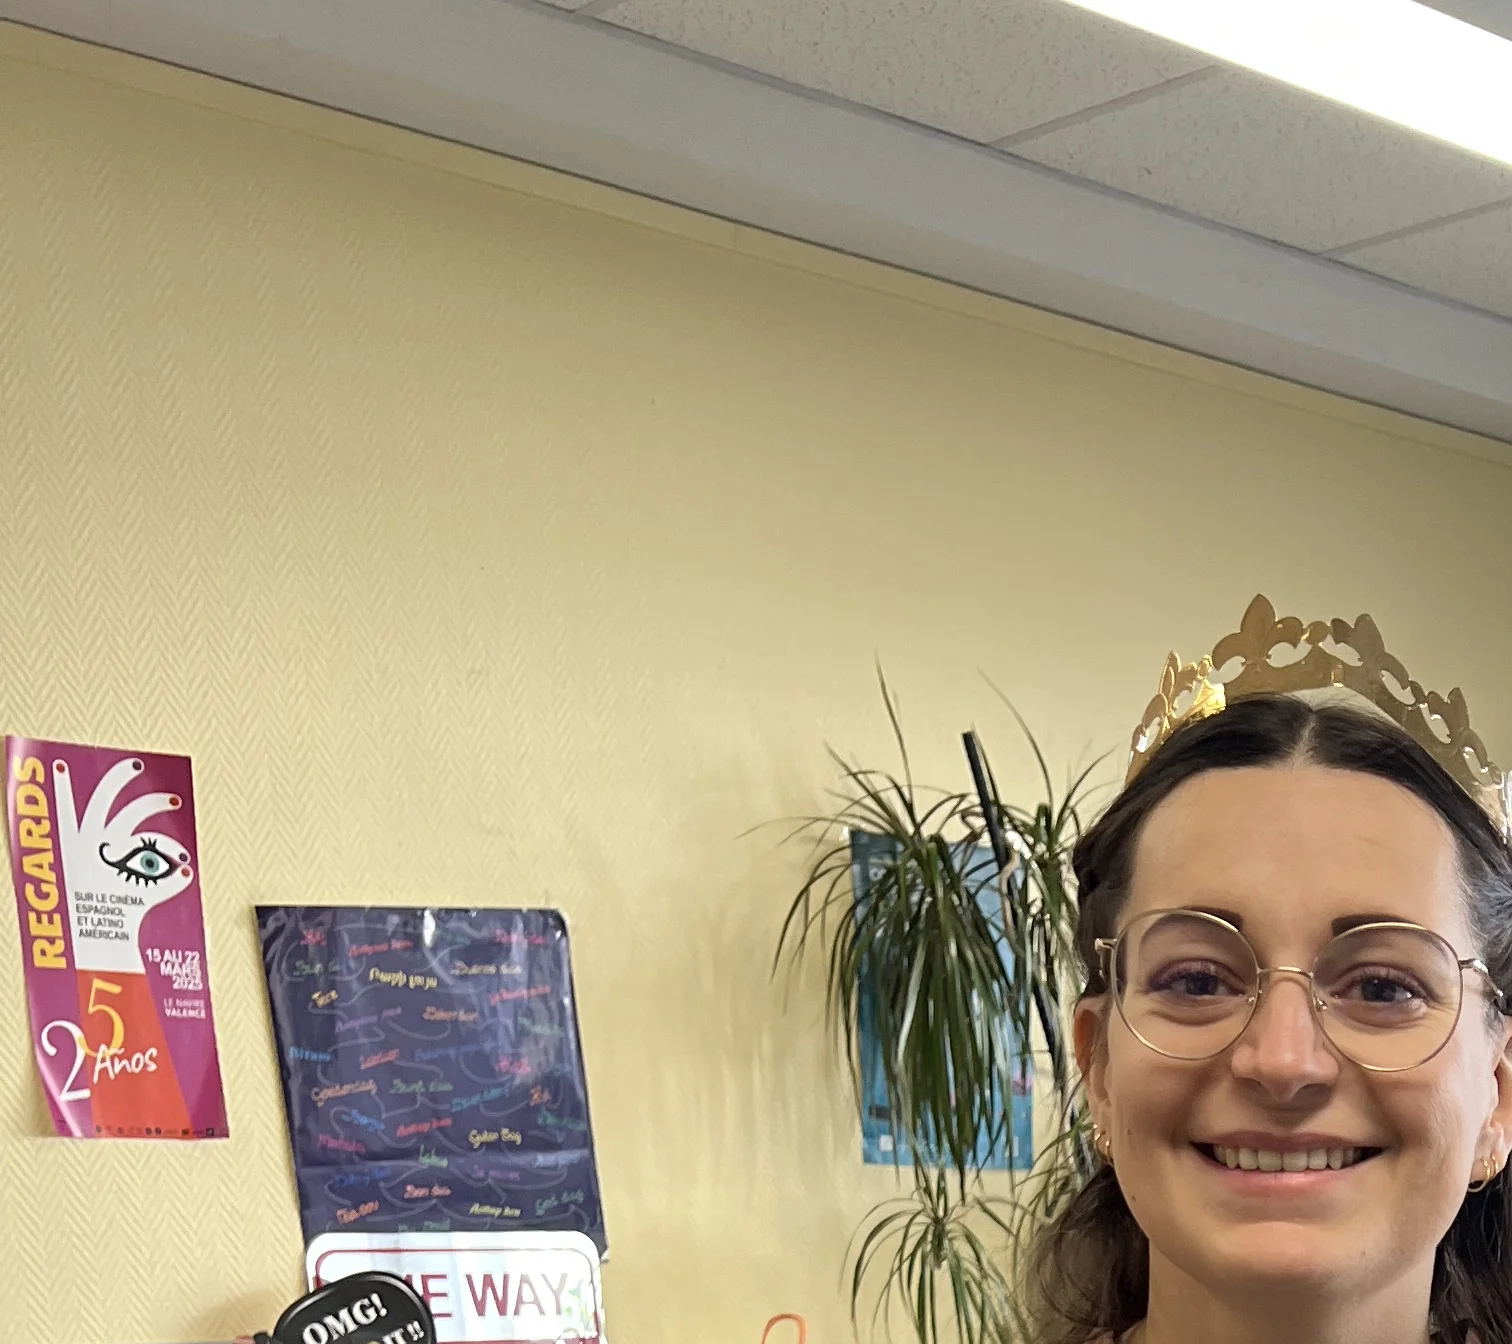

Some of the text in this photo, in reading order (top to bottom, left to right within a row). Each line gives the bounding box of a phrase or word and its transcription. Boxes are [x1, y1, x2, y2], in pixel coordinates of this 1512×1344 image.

[13, 755, 67, 970] REGARDS
[74, 891, 94, 902] SUR
[96, 893, 108, 904] LE
[76, 903, 127, 917] ESPAGNOL
[77, 916, 124, 929] ET LATINO
[163, 949, 182, 963] AU
[92, 1044, 158, 1086] Años
[465, 1272, 569, 1318] WAY
